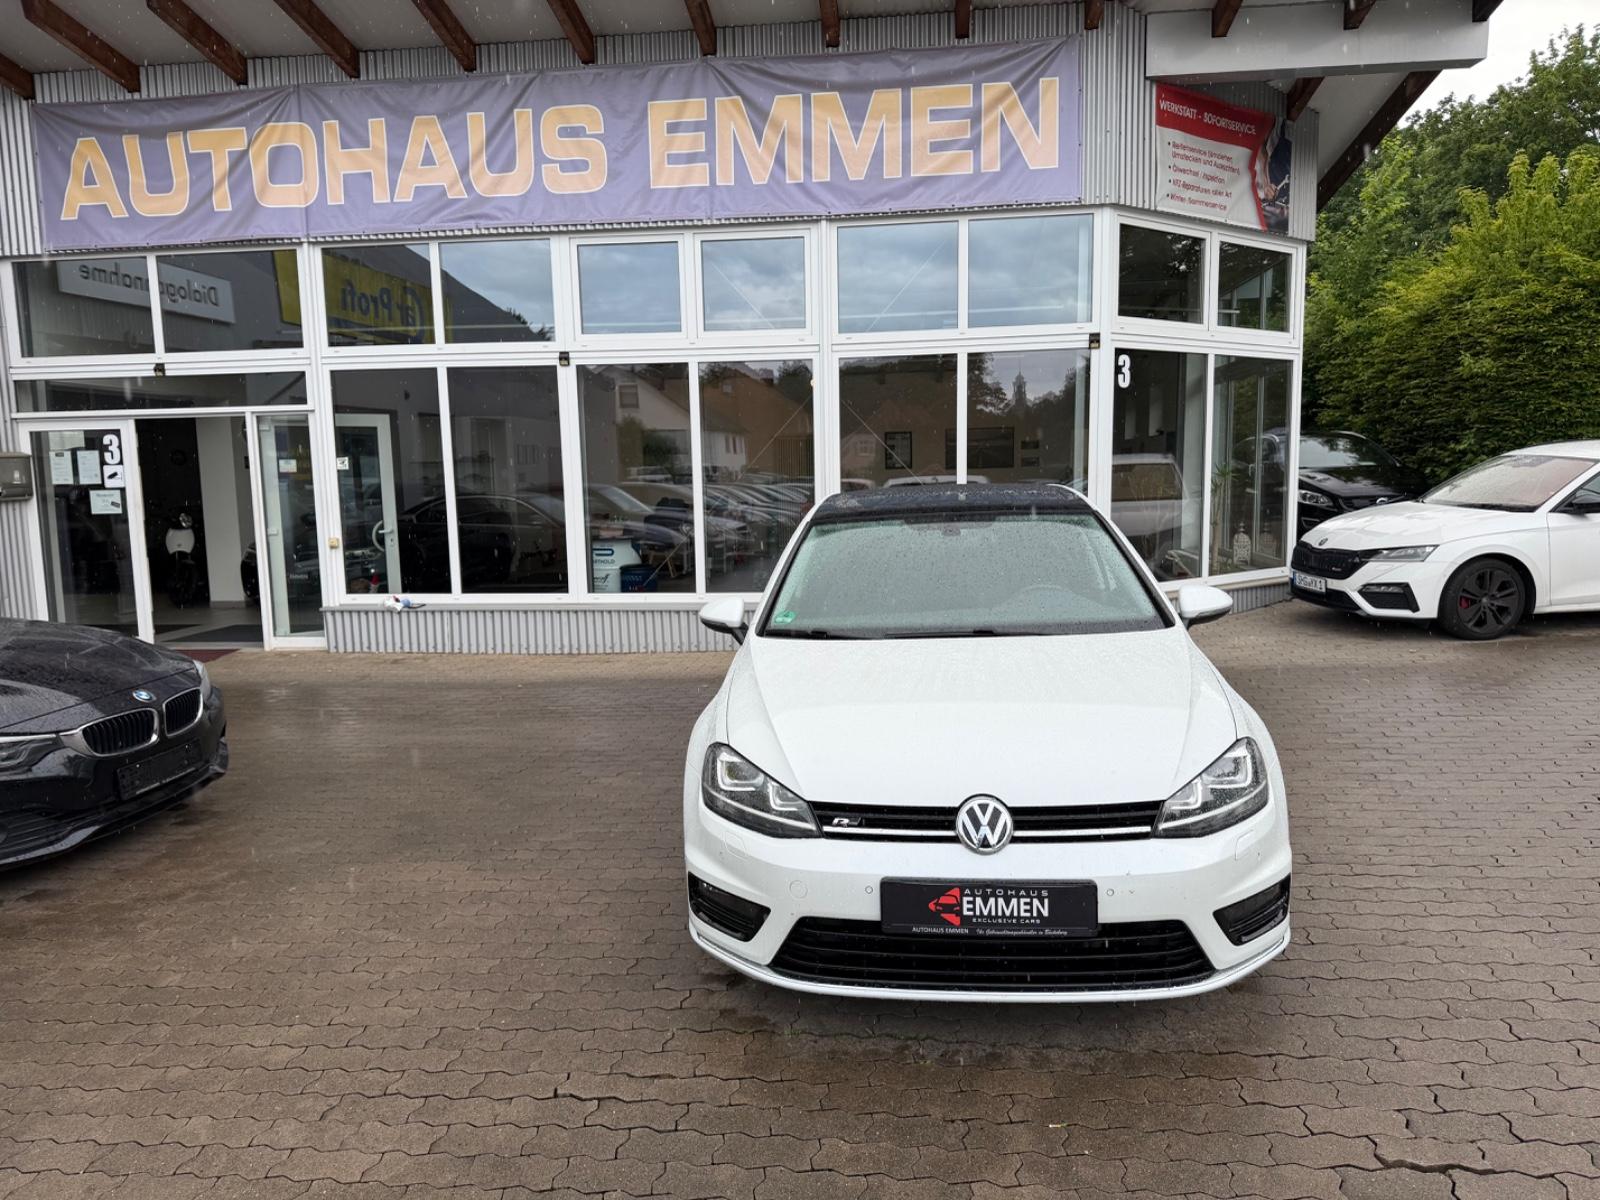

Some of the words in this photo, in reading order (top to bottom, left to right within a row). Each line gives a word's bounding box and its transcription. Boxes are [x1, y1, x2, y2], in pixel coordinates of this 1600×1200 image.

[1159, 99, 1197, 120] WERKSTATT
[60, 104, 608, 221] AUTOHAUS
[648, 77, 1059, 189] EMMEN
[1117, 354, 1131, 388] 3
[103, 434, 121, 464] 3
[957, 799, 1010, 851] VW
[964, 888, 1048, 897] AUTOHAUS
[962, 897, 1049, 917] EMMEN
[912, 926, 944, 934] AUTOHAUS
